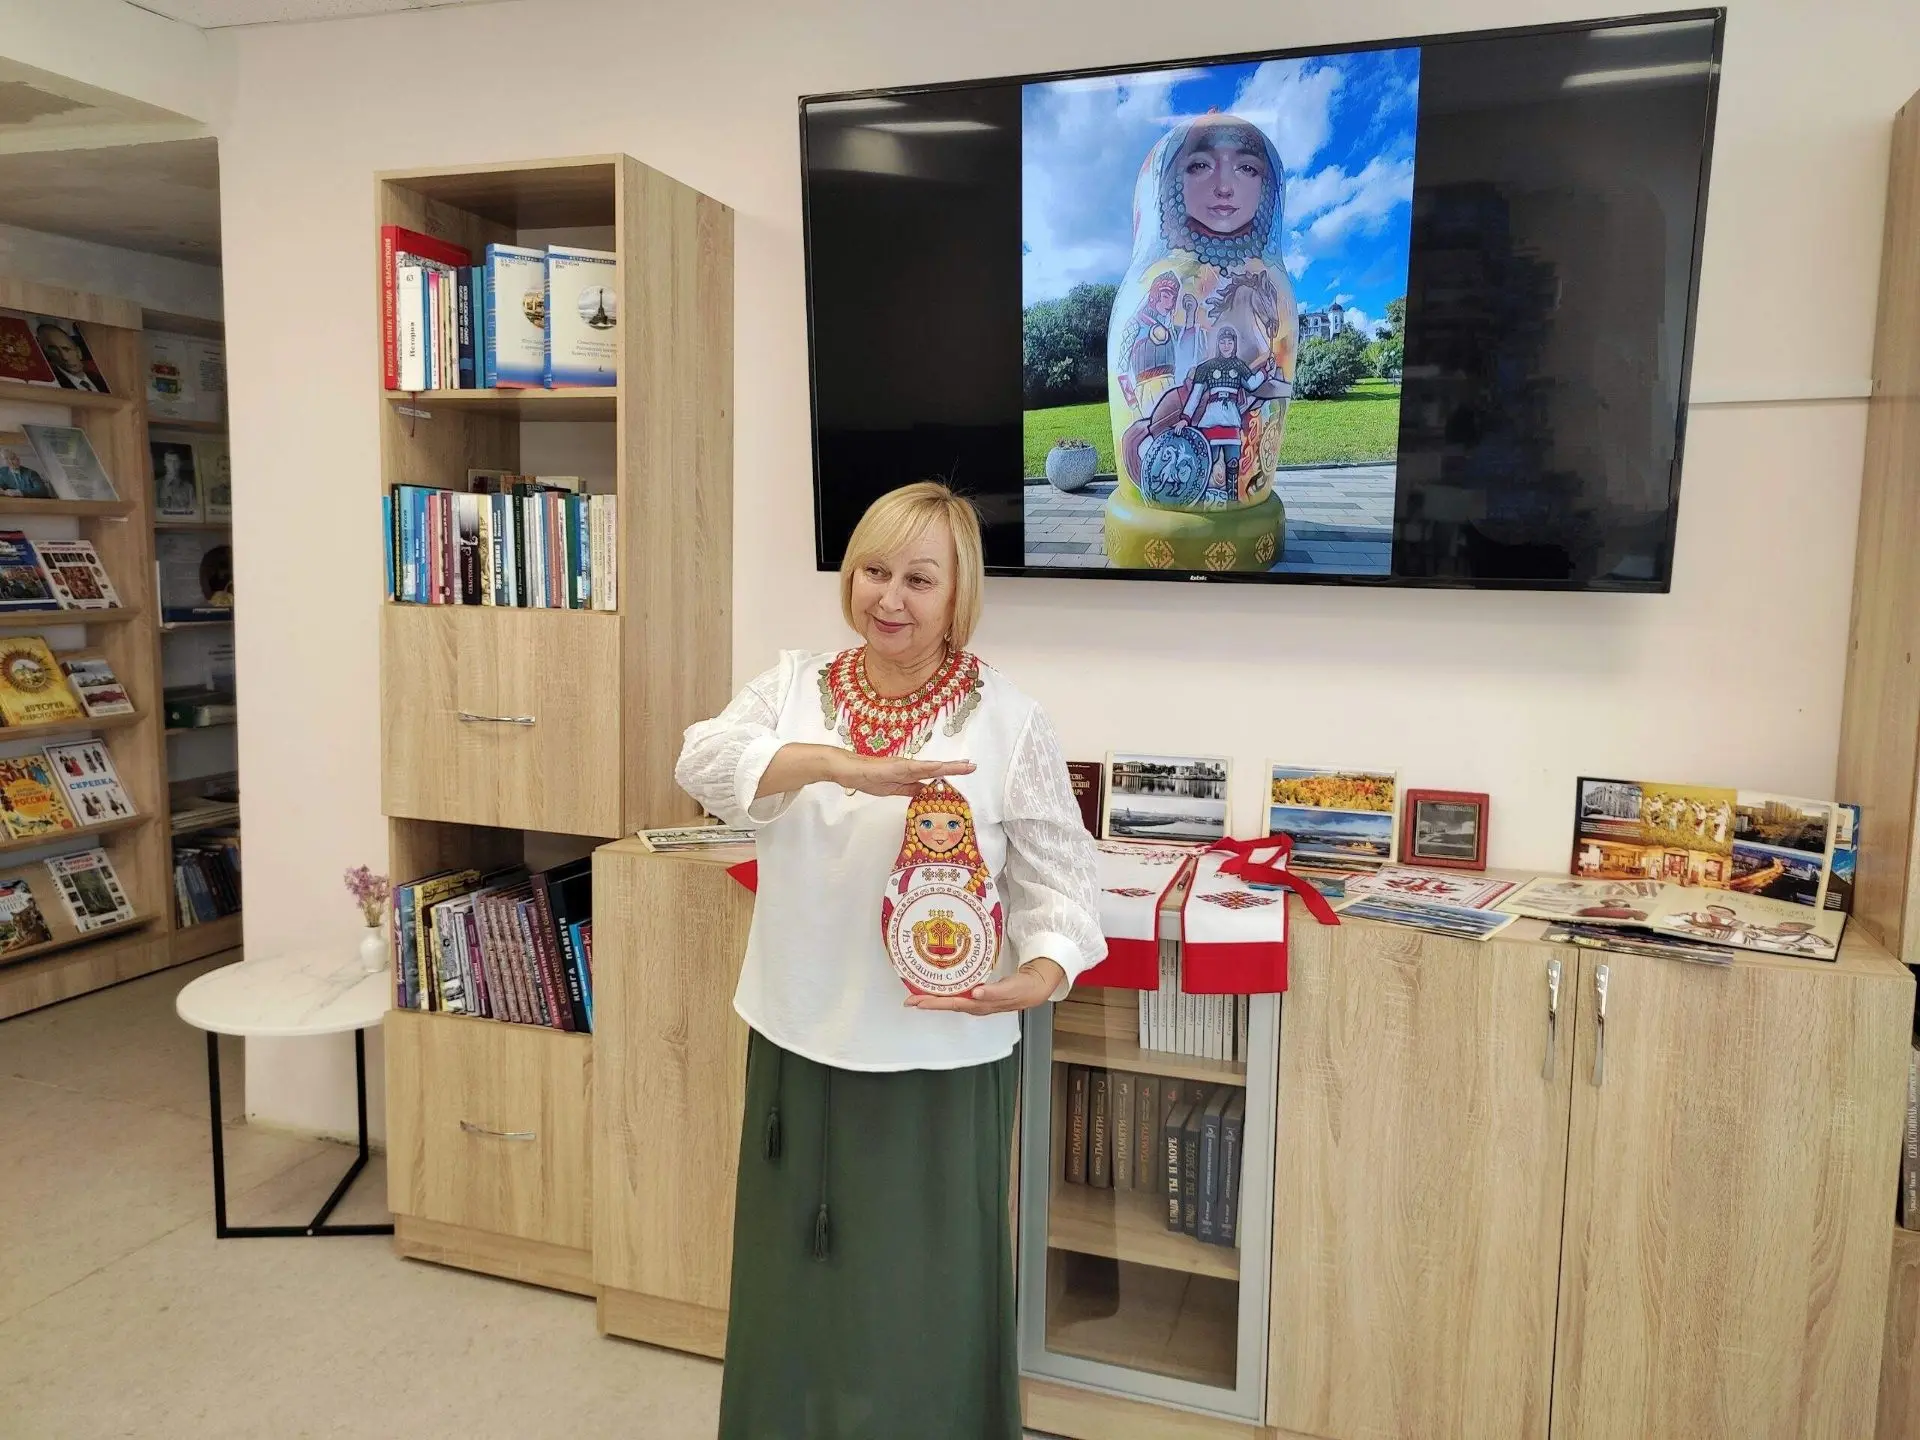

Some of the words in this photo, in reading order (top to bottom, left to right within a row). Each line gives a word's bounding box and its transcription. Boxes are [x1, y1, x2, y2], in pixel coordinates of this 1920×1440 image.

[559, 916, 573, 960] ПАМЯТИ
[568, 967, 580, 1002] КНИГА
[1097, 1080, 1105, 1093] 2
[1119, 1083, 1128, 1095] 3
[1168, 1091, 1177, 1102] 4
[1195, 1089, 1204, 1100] 5
[1072, 1115, 1082, 1154] ПАМЯТИ
[1094, 1115, 1104, 1156] ПАМЯТИ
[1117, 1119, 1128, 1158] ПАМЯТИ
[1141, 1122, 1150, 1162] ПАМЯТИ
[1168, 1137, 1178, 1164] МОРЕ
[1185, 1142, 1196, 1169] МОРЕ
[1168, 1165, 1178, 1175] И
[1168, 1177, 1178, 1193] ТЫ
[1185, 1180, 1195, 1196] ТЫ
